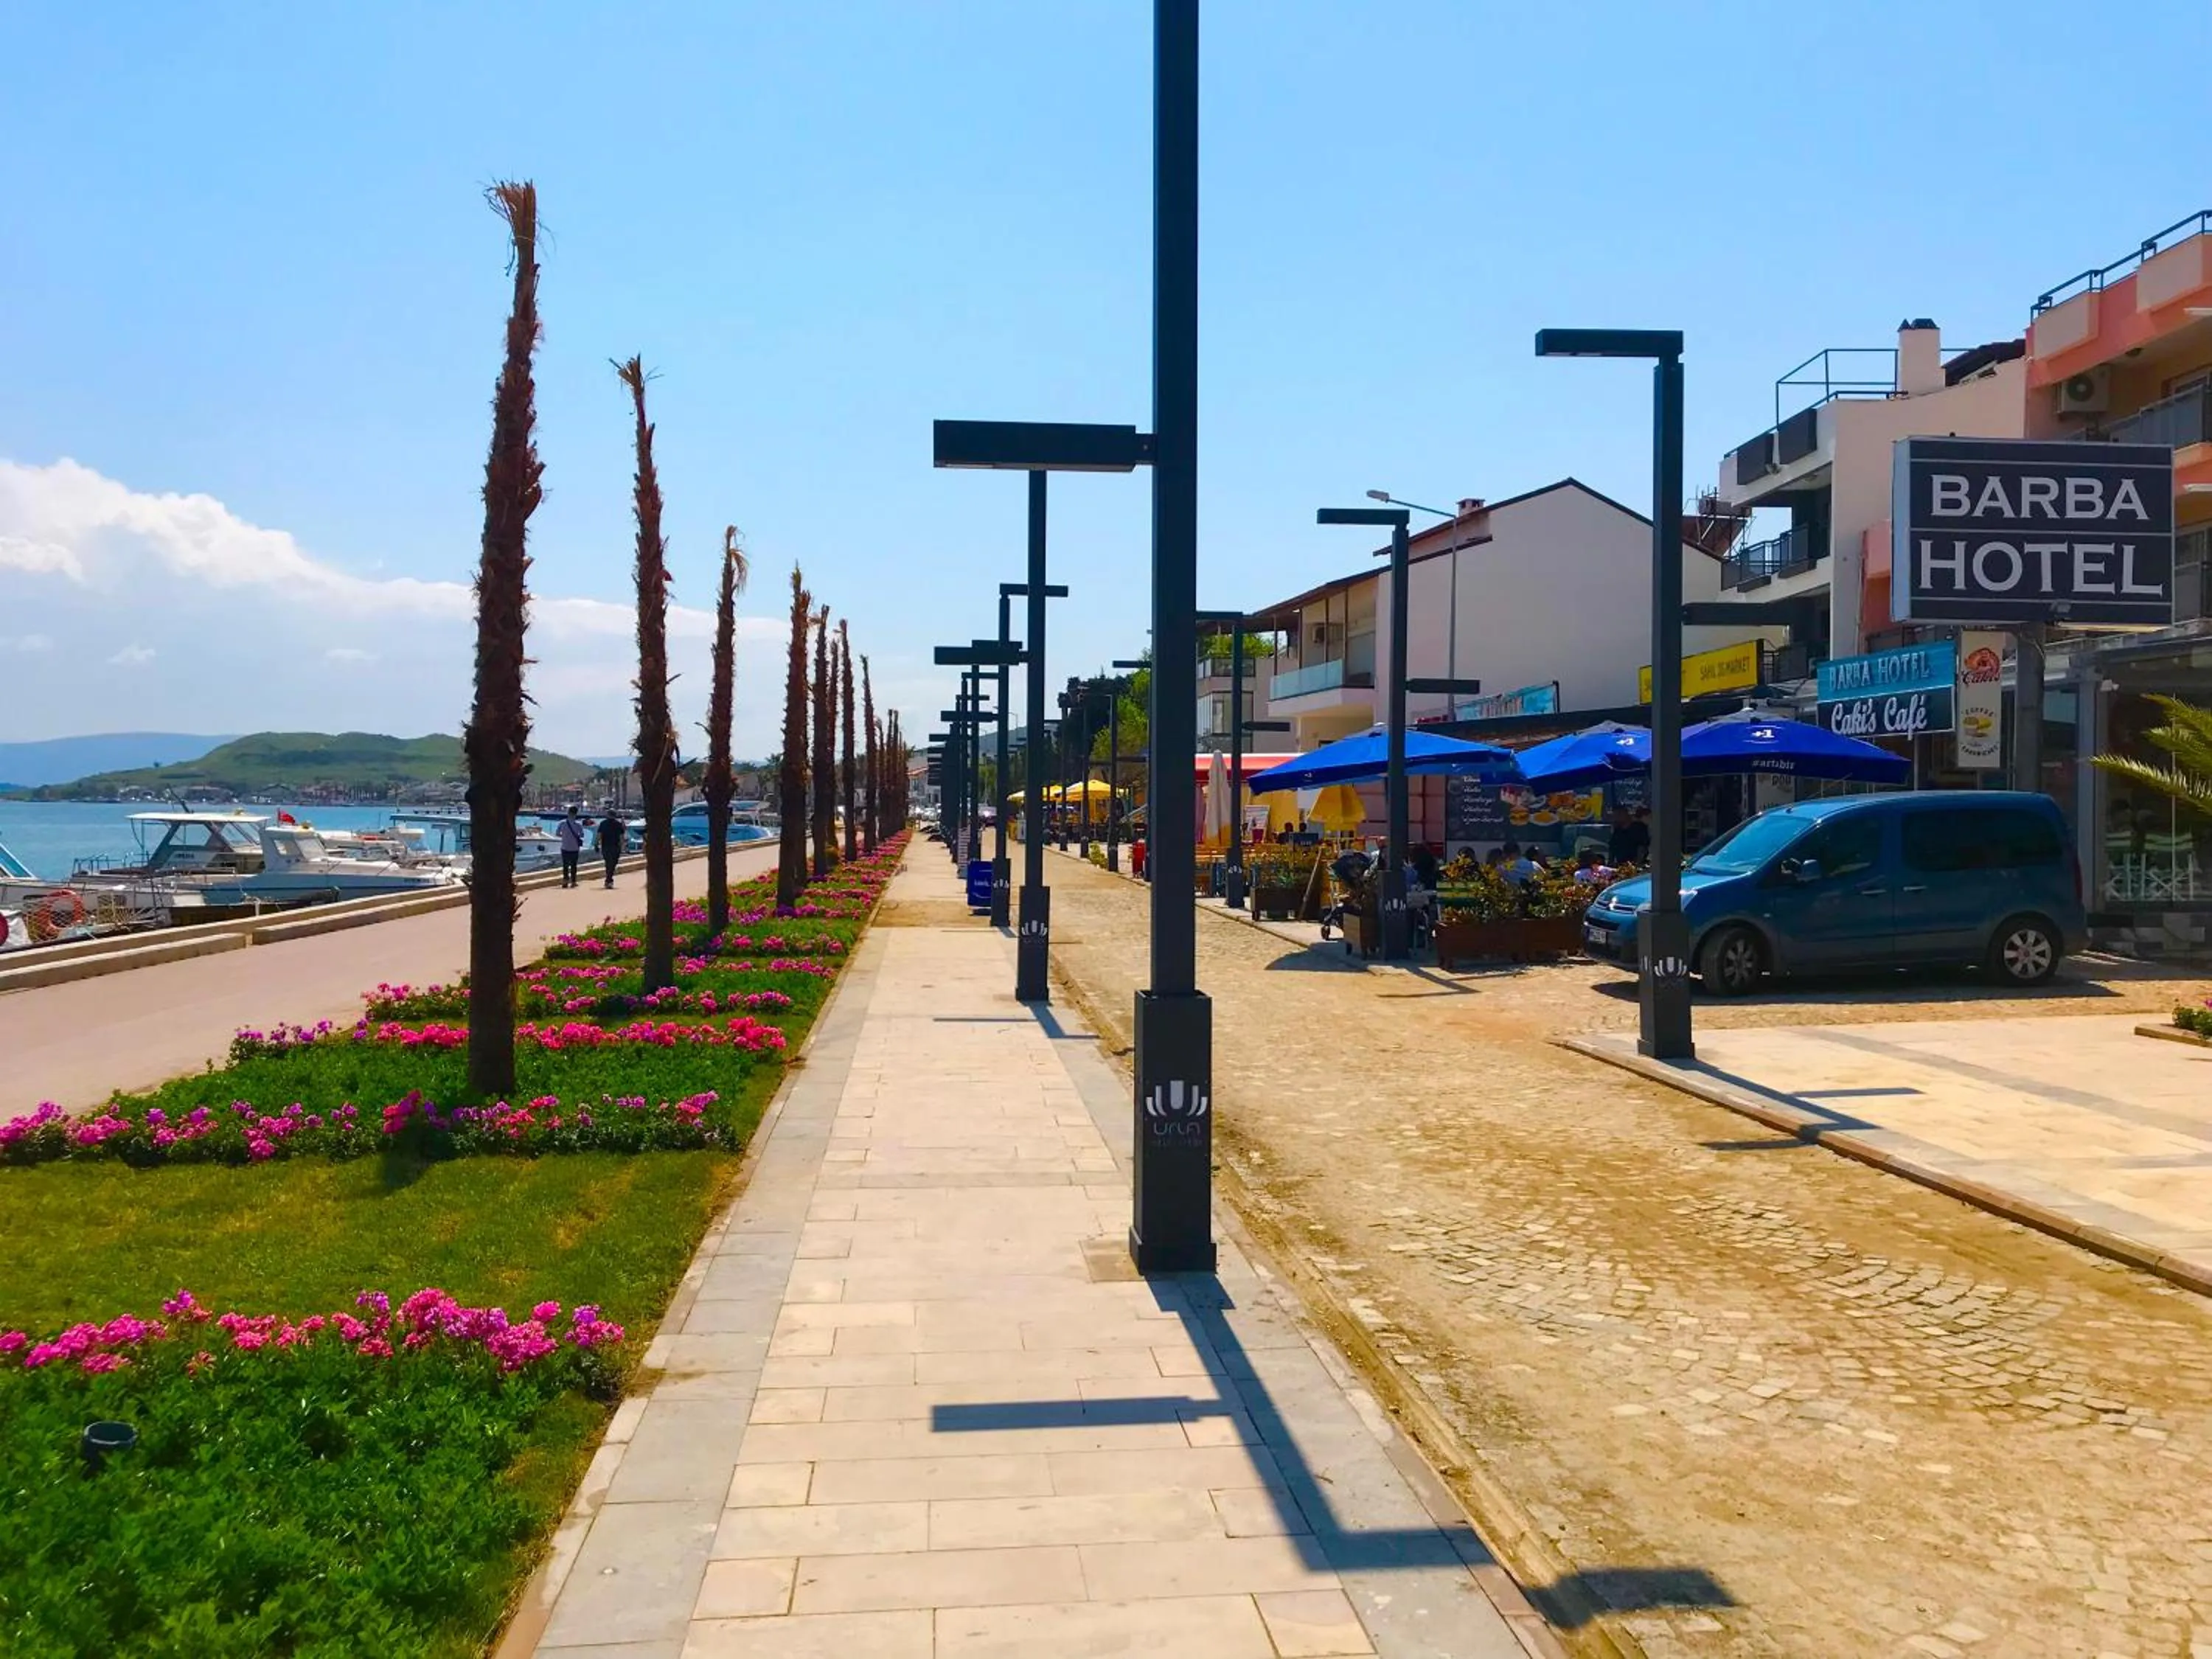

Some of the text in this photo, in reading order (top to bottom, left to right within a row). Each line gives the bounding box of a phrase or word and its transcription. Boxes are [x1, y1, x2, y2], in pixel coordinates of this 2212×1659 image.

[1930, 474, 2151, 521] BARBA
[1919, 539, 2163, 598] HOTEL
[1829, 650, 1930, 692] BARBA HOTEL
[1831, 694, 1928, 741] Caki's Café
